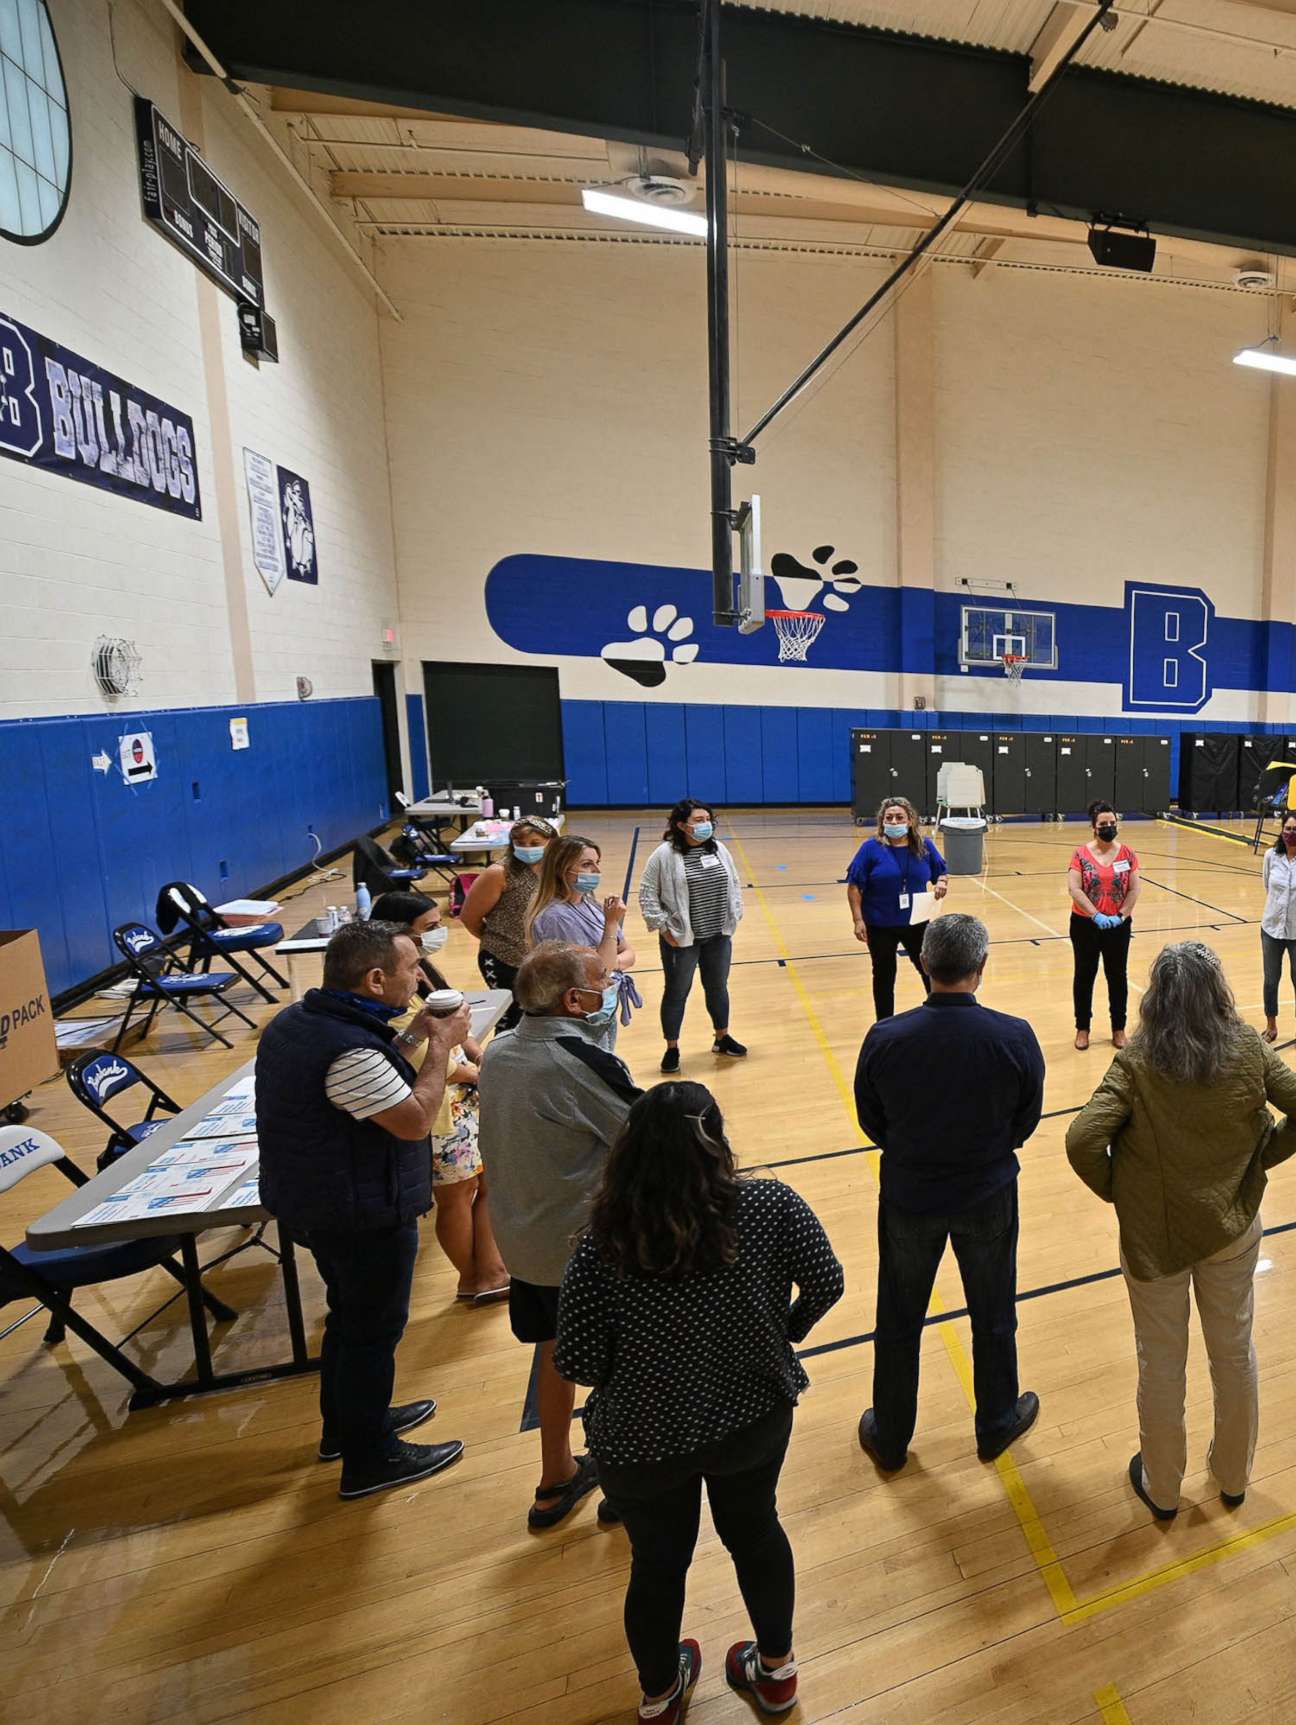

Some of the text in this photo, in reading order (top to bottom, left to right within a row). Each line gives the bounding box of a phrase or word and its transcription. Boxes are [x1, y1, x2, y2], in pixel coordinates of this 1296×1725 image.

[142, 140, 158, 202] fair-play.com
[159, 119, 182, 161] HOME
[44, 356, 196, 505] BULLDOGS
[1122, 580, 1215, 714] B
[12, 994, 45, 1030] PACK
